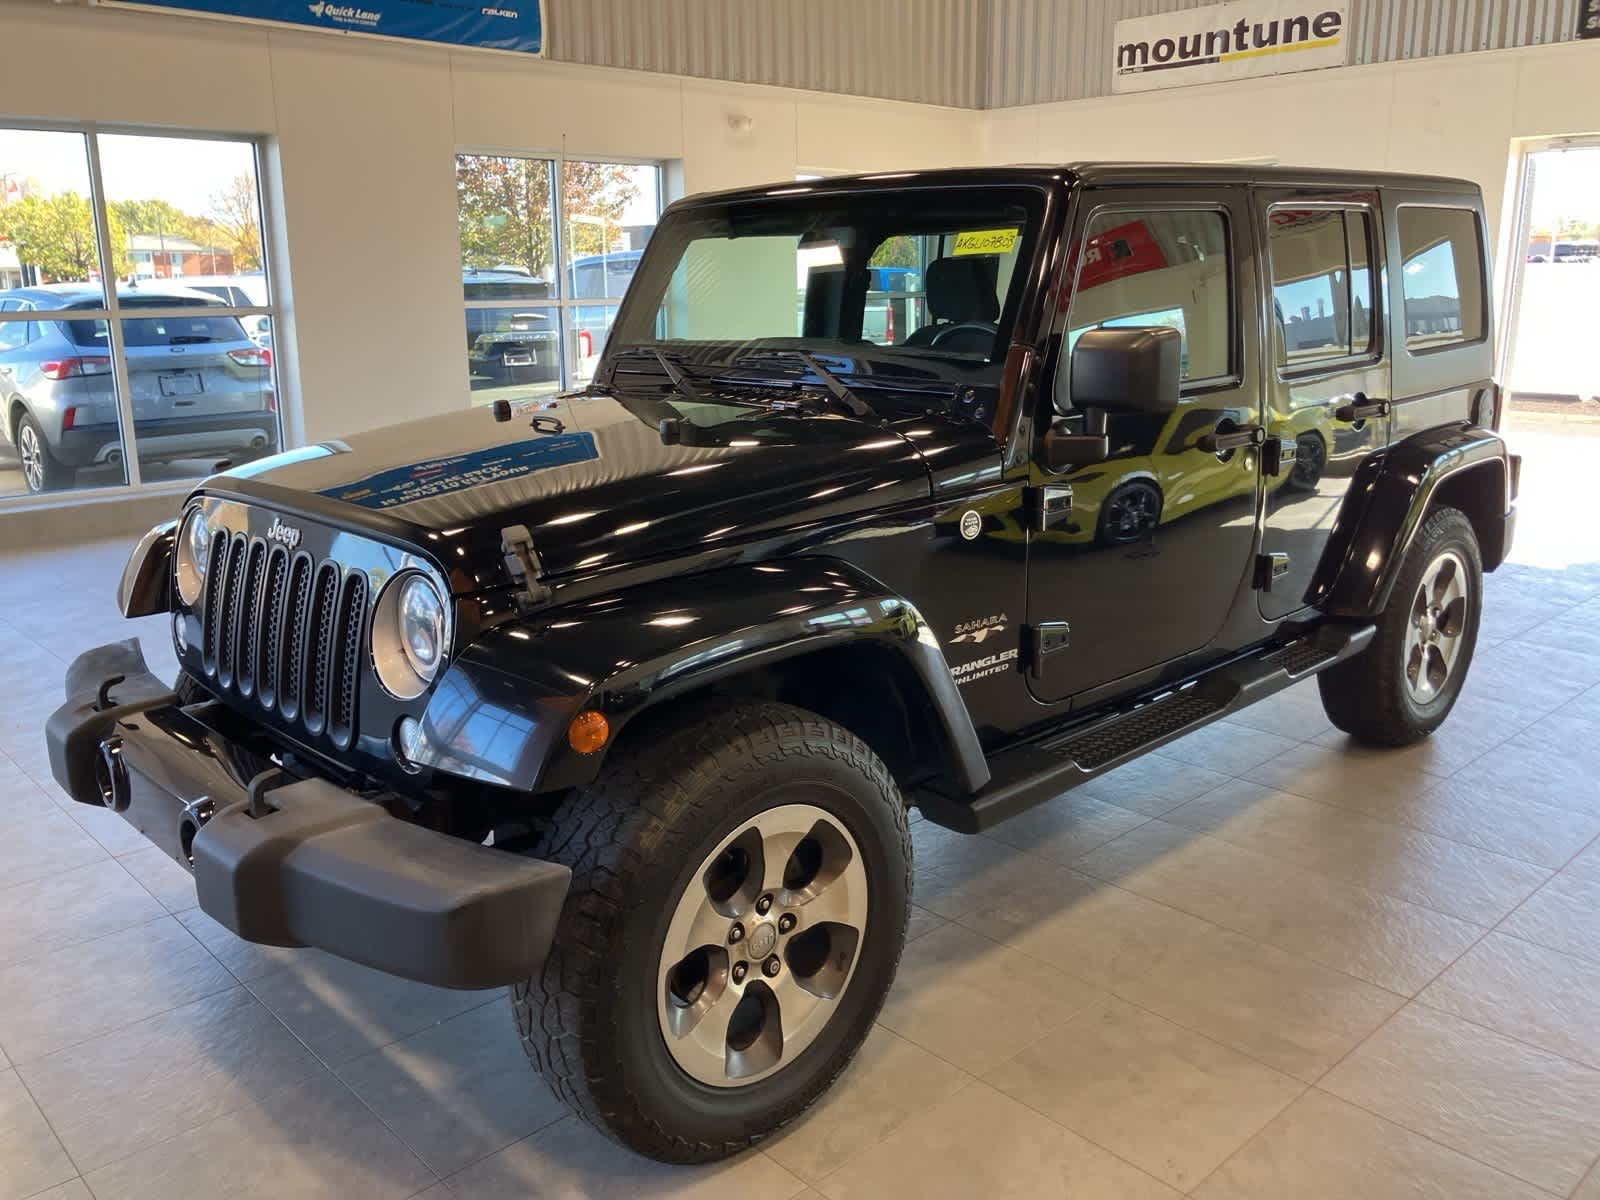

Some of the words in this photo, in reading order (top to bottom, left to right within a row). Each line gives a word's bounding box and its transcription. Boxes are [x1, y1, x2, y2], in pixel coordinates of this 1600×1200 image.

[325, 4, 354, 18] Quick
[355, 8, 382, 21] Lane
[481, 7, 518, 19] FALKEN
[1117, 11, 1343, 68] mountune
[267, 517, 301, 550] Jeep
[954, 613, 1008, 634] SAHARA
[950, 647, 1019, 677] RANGLER
